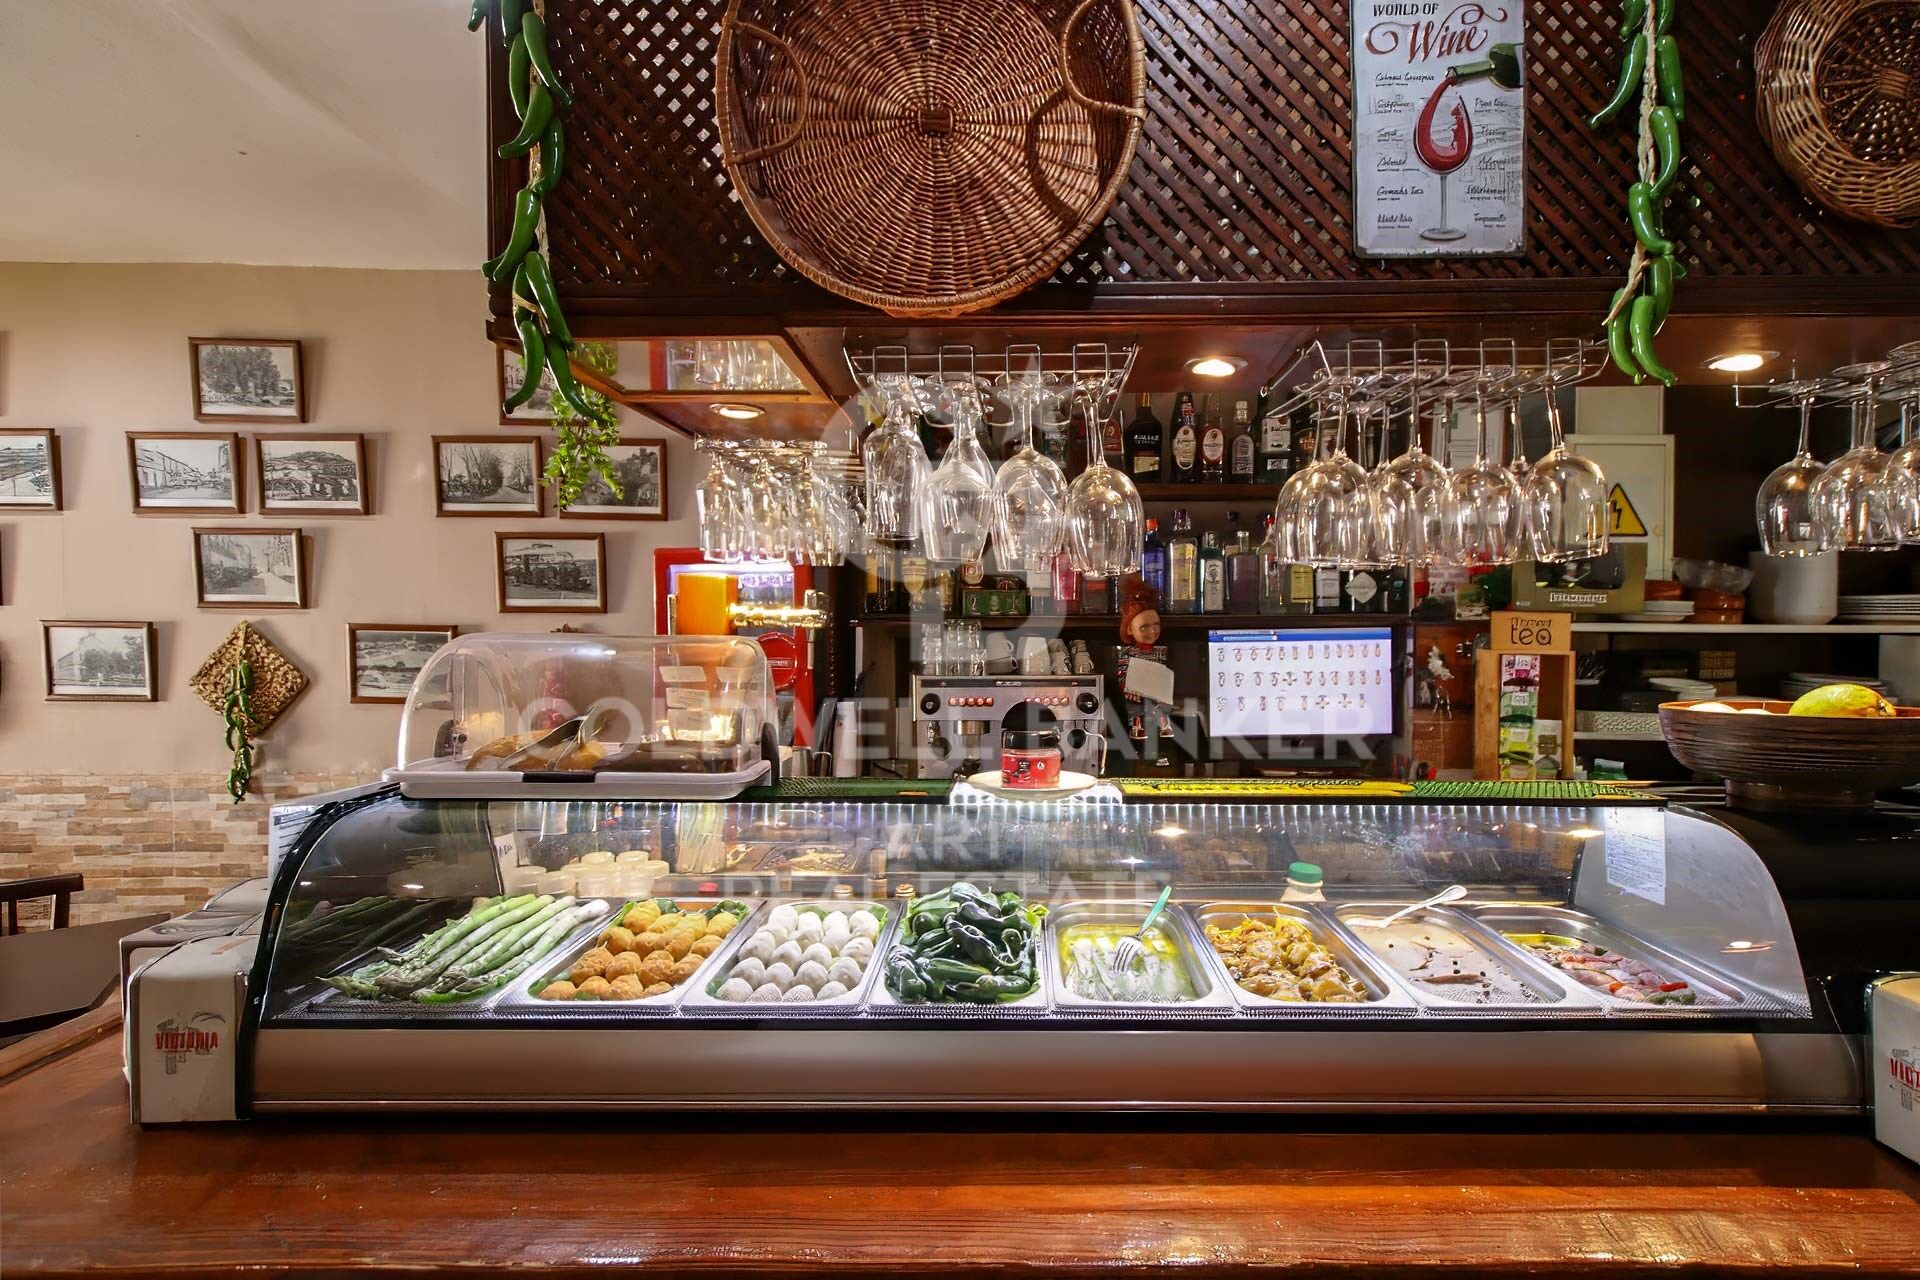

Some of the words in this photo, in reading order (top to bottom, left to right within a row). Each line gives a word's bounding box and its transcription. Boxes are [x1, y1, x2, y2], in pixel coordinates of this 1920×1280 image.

[1373, 3, 1419, 16] WORLD
[1422, 2, 1440, 15] OF
[1365, 3, 1508, 64] Wine
[1511, 623, 1552, 646] tea
[155, 1031, 219, 1050] VICTORIA
